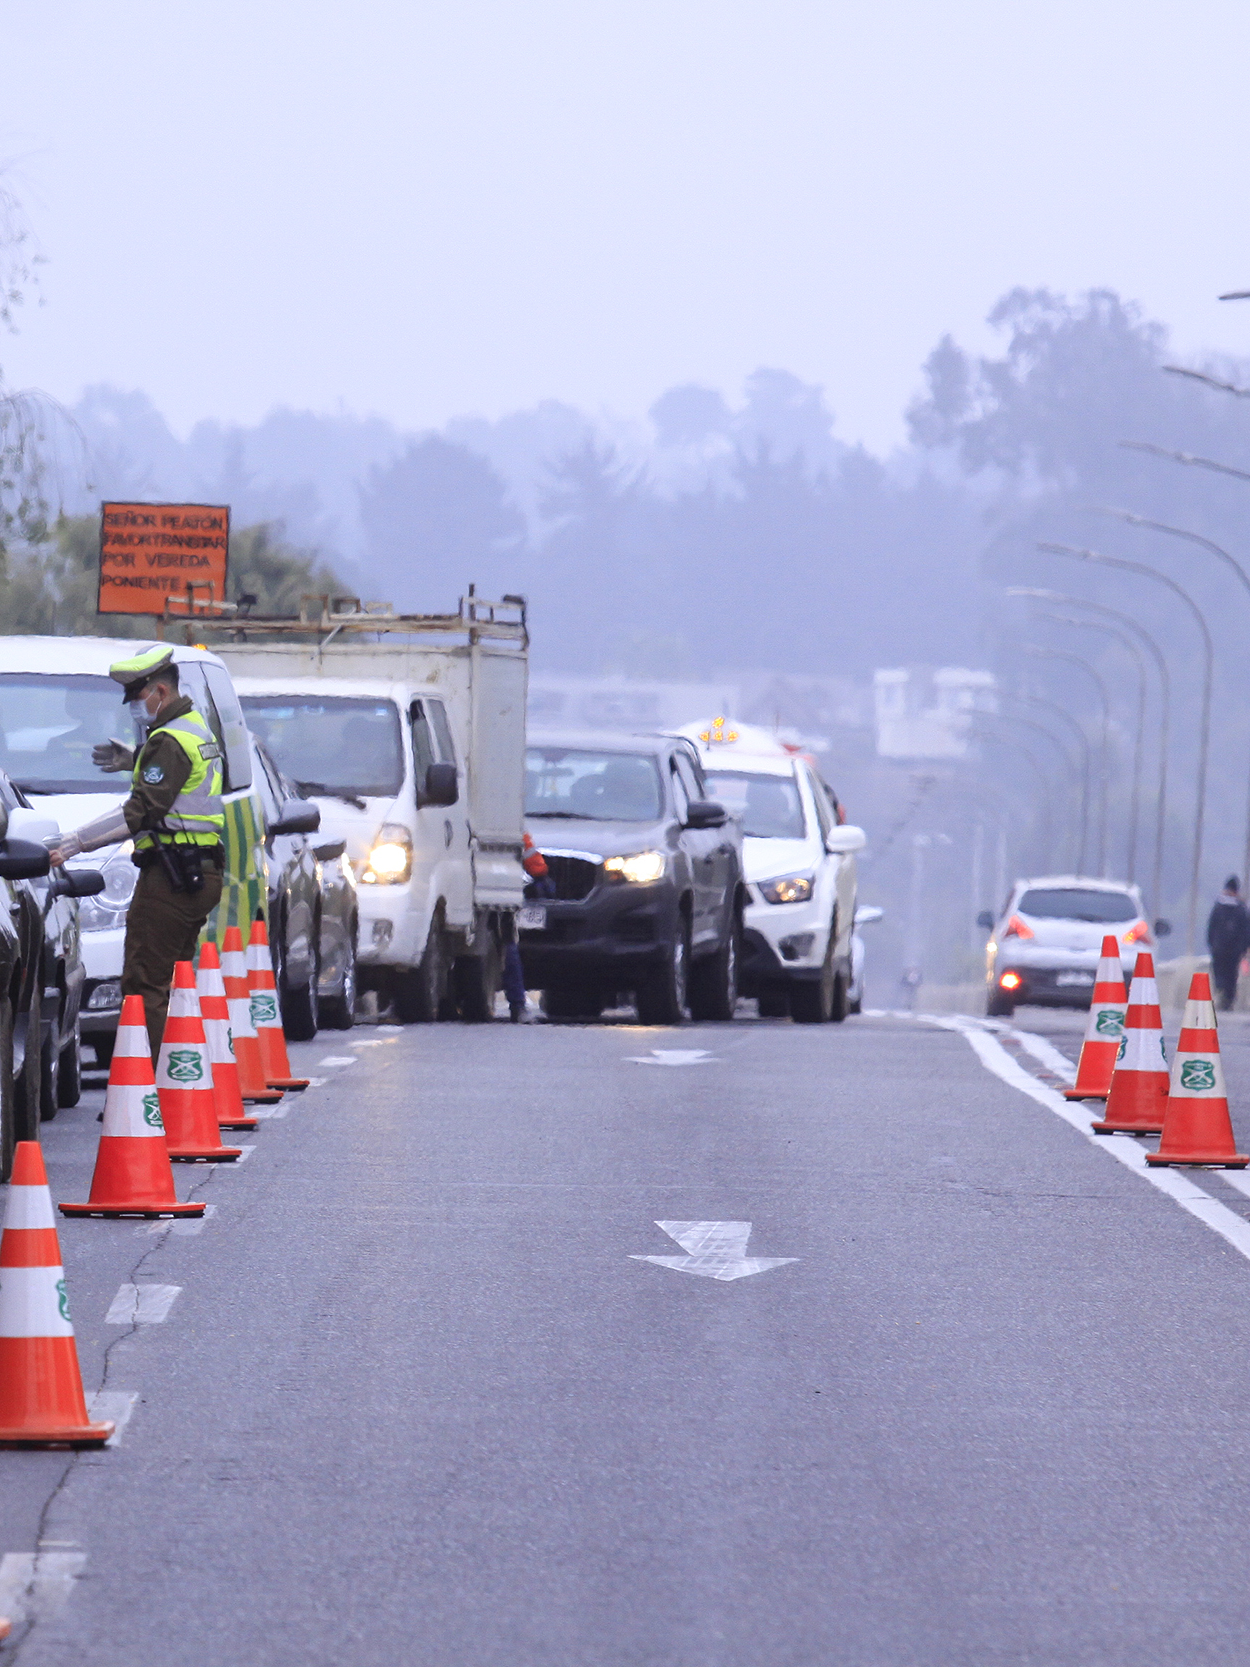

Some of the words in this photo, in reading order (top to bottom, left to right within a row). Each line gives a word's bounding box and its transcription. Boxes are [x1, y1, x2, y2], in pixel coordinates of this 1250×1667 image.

[106, 510, 157, 527] SEÑOR
[102, 552, 135, 567] POR
[145, 553, 211, 568] VEREDA
[102, 575, 180, 592] PONIENTE
